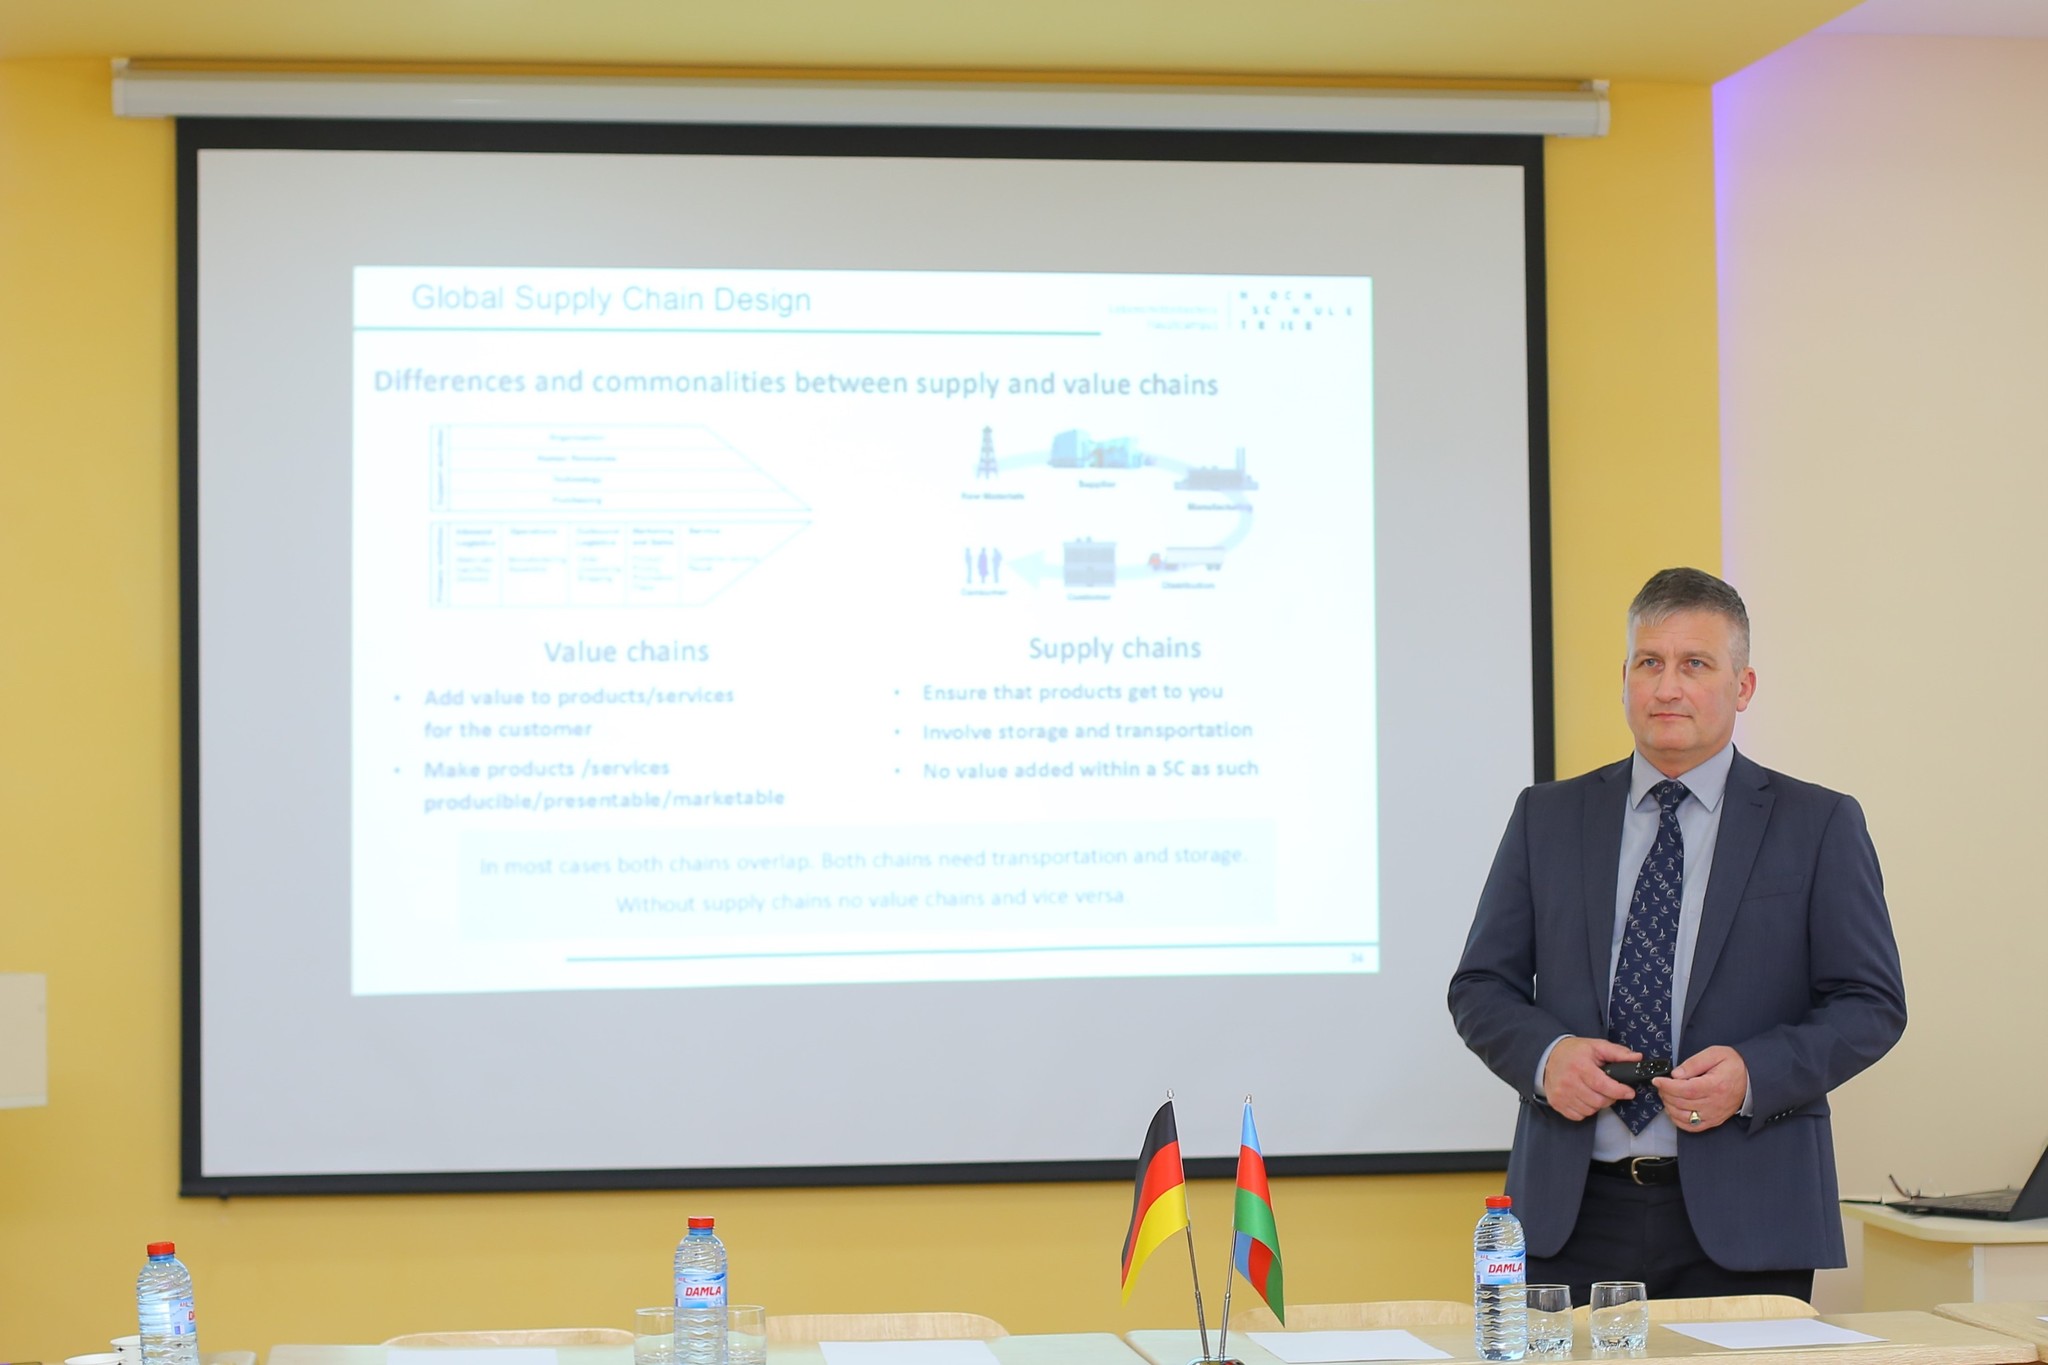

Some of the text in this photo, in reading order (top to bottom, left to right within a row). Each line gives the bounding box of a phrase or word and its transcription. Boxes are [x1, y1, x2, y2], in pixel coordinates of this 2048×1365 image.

[412, 284, 811, 318] Global Supply Chain Design
[374, 368, 1219, 399] Differences and commonalities between supply and value chains
[544, 640, 709, 663] Value chains
[1029, 636, 1201, 664] Supply chains
[424, 687, 734, 708] Add value to products/services
[923, 683, 1223, 704] Ensure that products get to you
[424, 721, 593, 739] for the customer
[923, 721, 1253, 743] Involve storage and transportation
[424, 761, 481, 778] Make
[487, 760, 575, 781] products
[923, 759, 1260, 780] No value added within a SC as such
[423, 789, 785, 815] producible/presentable/marketable
[480, 858, 498, 875] In
[504, 858, 553, 875] most
[559, 860, 611, 875] cases
[617, 856, 663, 874] both
[669, 856, 731, 873] chains
[821, 851, 867, 870] Both
[872, 851, 932, 868] chains
[938, 850, 986, 867] need
[991, 849, 1128, 869] transportation
[1133, 847, 1168, 864] and
[616, 896, 695, 913] Without
[702, 894, 765, 914] supply
[771, 893, 832, 910] chains
[838, 895, 864, 909] no
[868, 891, 919, 908] value
[925, 890, 985, 907] chains
[991, 888, 1027, 906] and
[1032, 890, 1068, 904] vice
[1488, 1263, 1523, 1274] DAMLA
[685, 1285, 722, 1297] DAMLA
